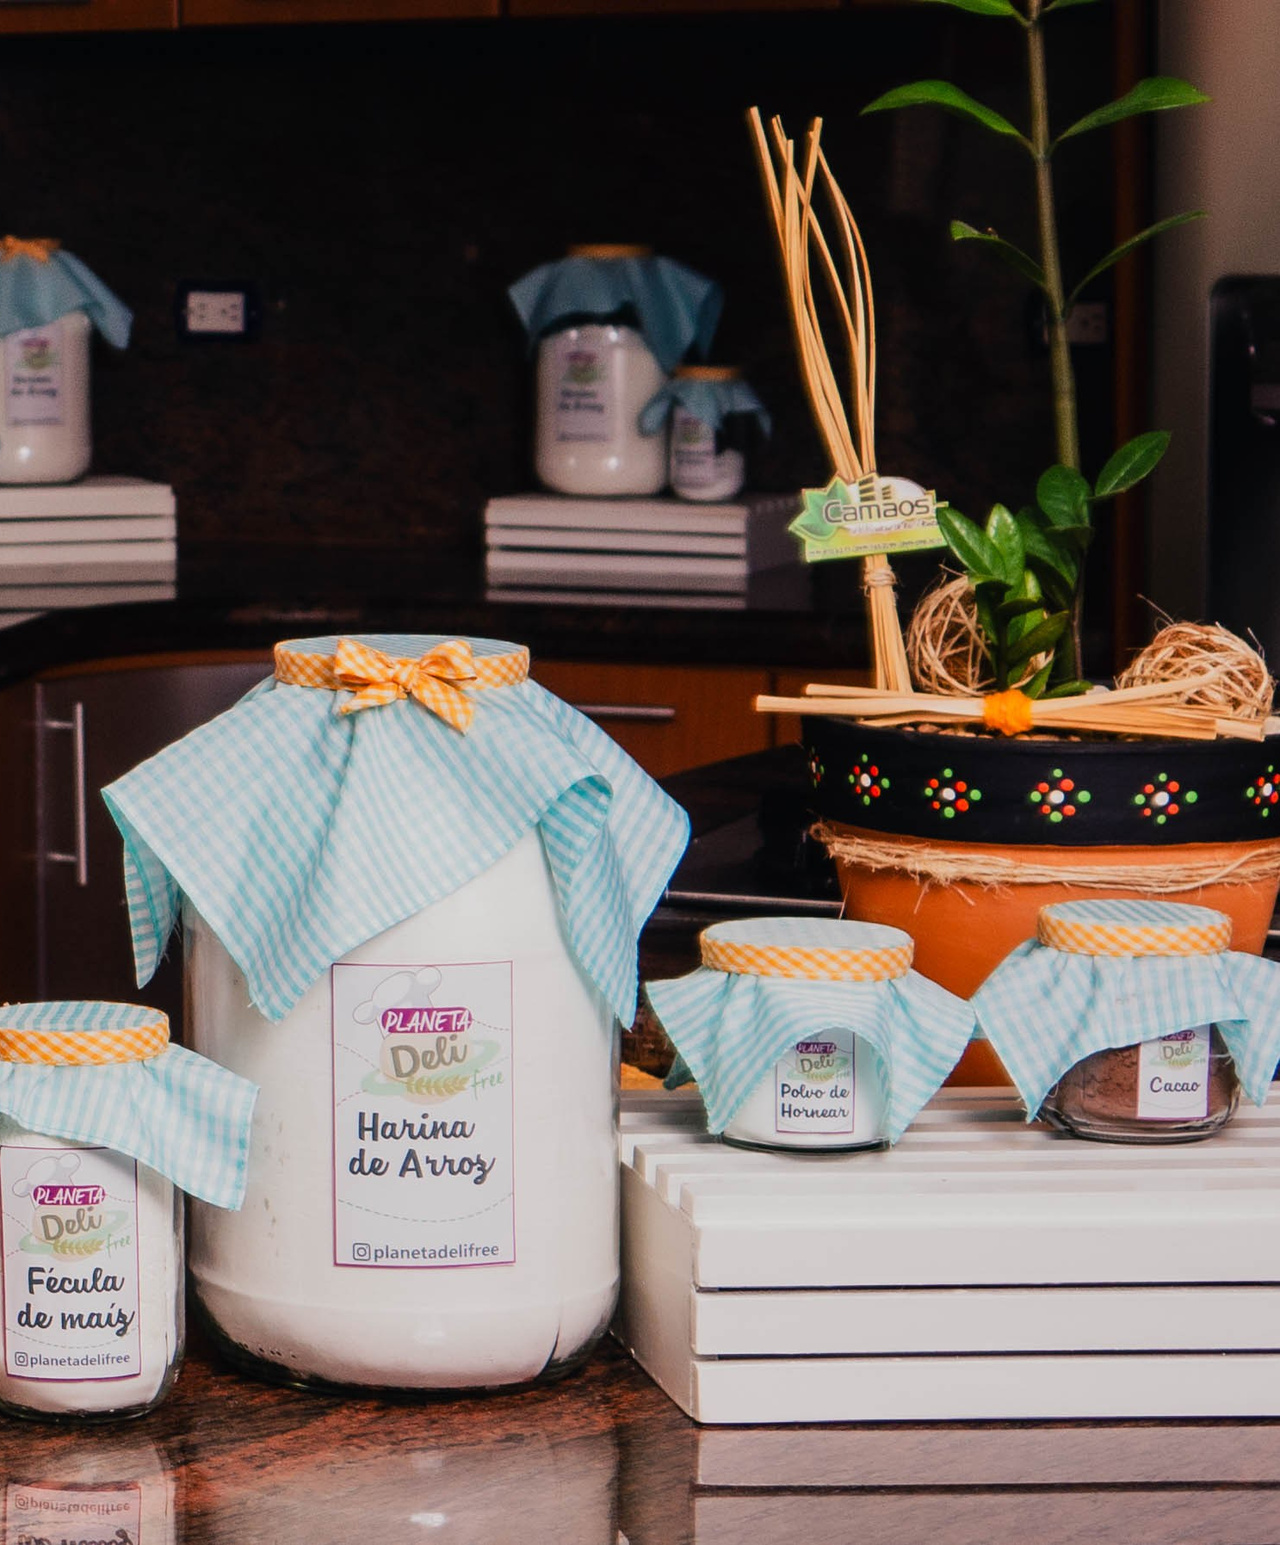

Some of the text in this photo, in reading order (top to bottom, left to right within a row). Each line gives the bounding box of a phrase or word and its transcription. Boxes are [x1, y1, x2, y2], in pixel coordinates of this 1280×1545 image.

[824, 498, 930, 524] Camaos
[383, 1010, 472, 1033] PLANETA
[390, 1034, 467, 1078] Deli
[797, 1042, 836, 1053] PLANETA
[1162, 1041, 1193, 1059] Deli
[800, 1054, 834, 1073] Deli
[470, 1069, 504, 1100] free
[781, 1083, 850, 1098] Polvo de
[1150, 1076, 1200, 1093] Cacao
[781, 1102, 849, 1118] Hornear
[357, 1111, 476, 1141] Harina
[348, 1148, 496, 1185] de Arroz
[36, 1187, 105, 1205] PLANETA
[41, 1206, 102, 1240] Deli
[106, 1233, 130, 1258] free
[373, 1243, 500, 1262] planetadelifree
[27, 1266, 125, 1294] Fécula
[17, 1302, 136, 1337] de maíz
[30, 1353, 131, 1368] planetadelifree
